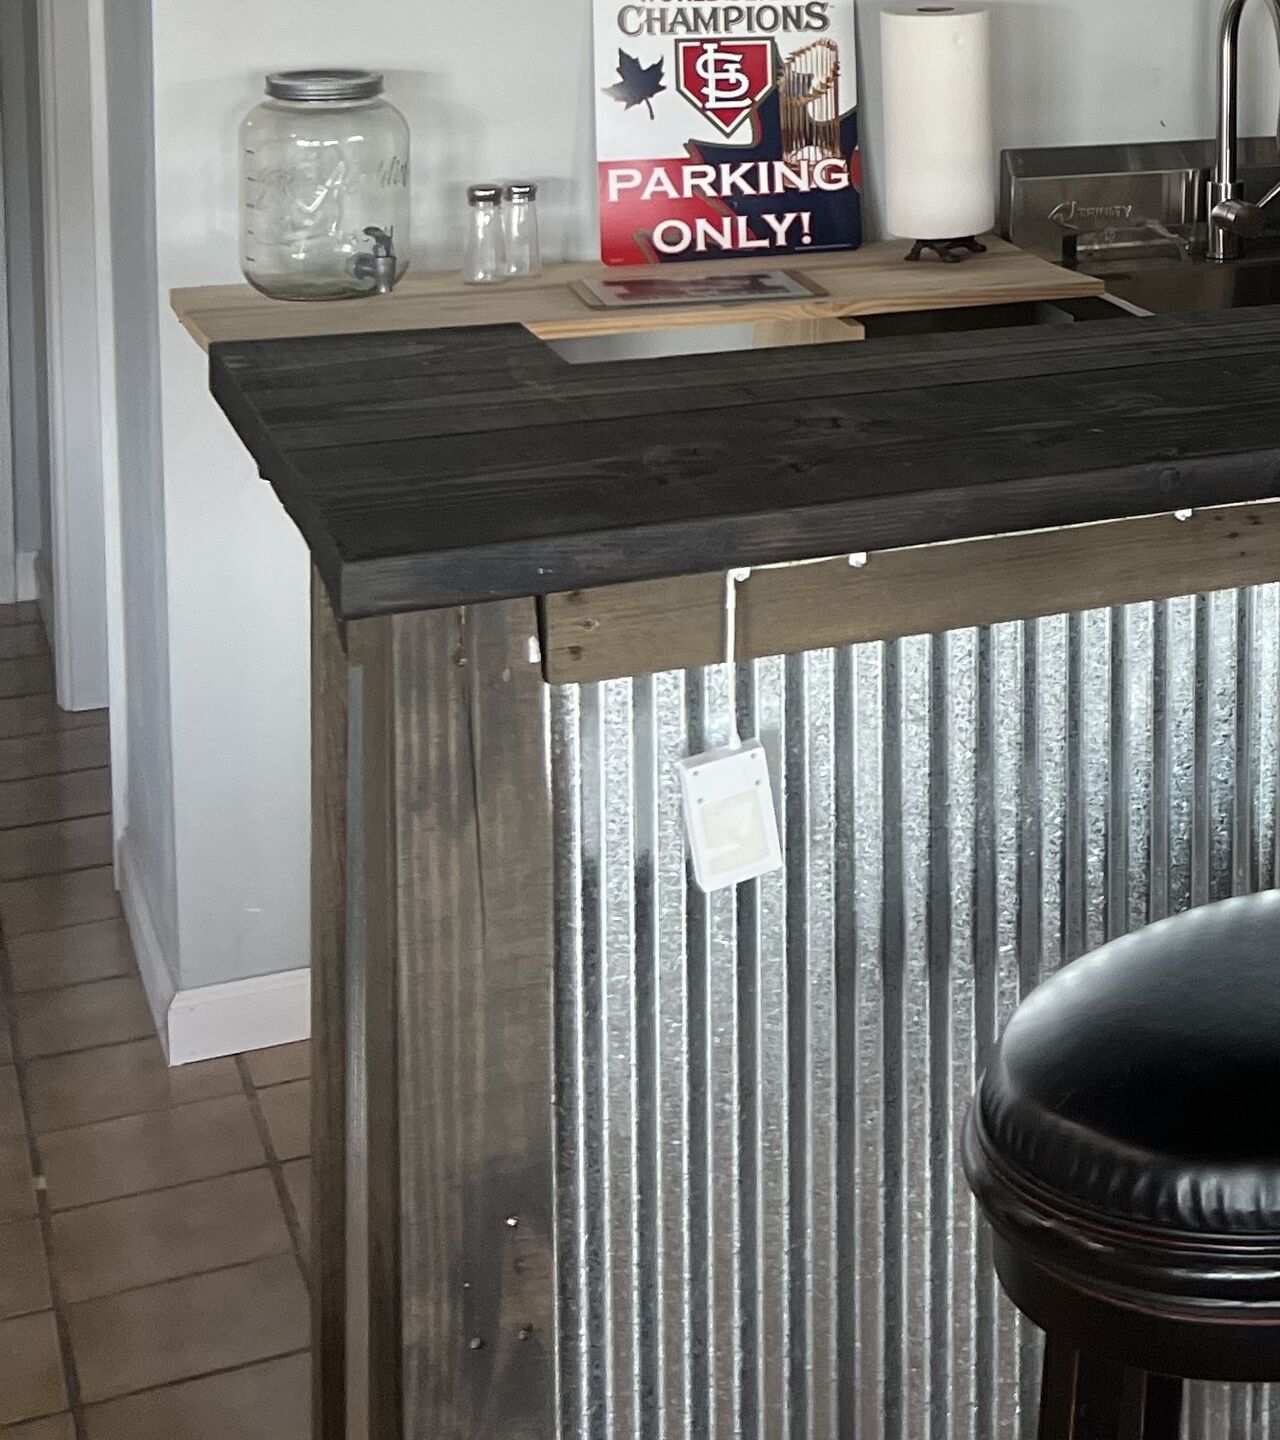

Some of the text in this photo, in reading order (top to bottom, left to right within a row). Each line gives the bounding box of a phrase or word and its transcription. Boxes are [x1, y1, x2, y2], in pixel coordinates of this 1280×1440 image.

[617, 1, 832, 36] CHAMPIONS
[608, 159, 850, 203] PARKING
[652, 211, 814, 255] ONLY!
